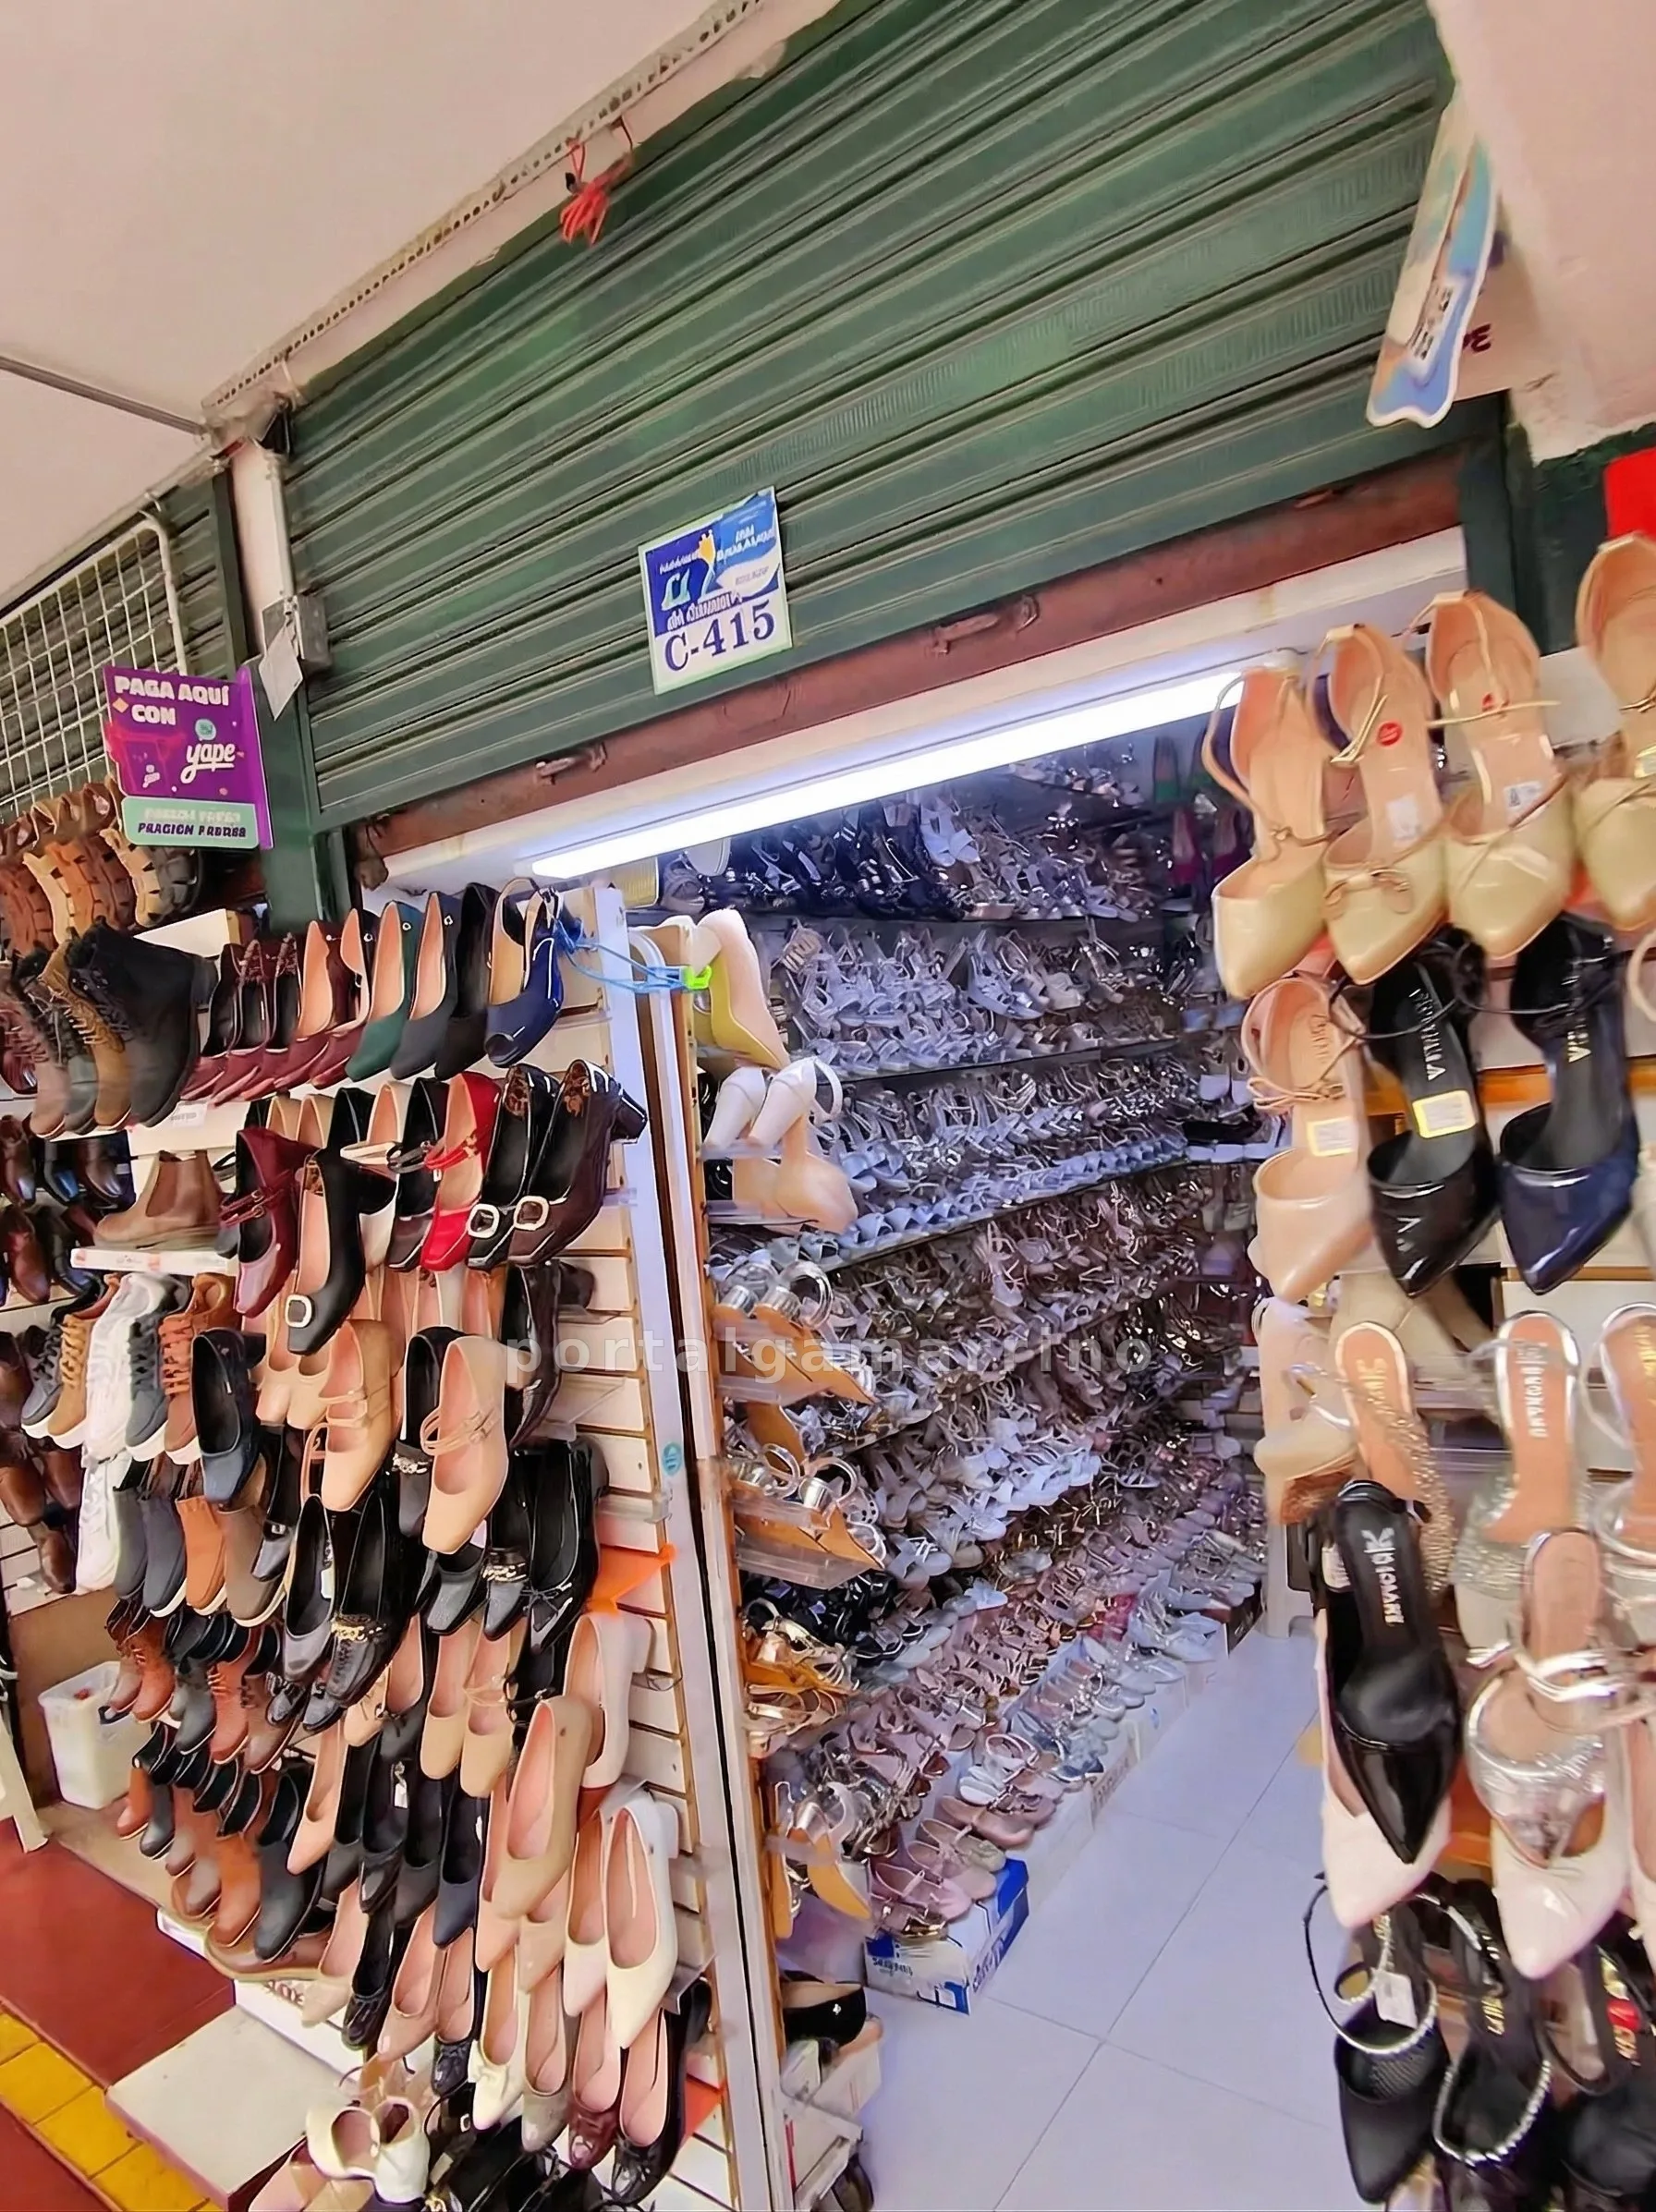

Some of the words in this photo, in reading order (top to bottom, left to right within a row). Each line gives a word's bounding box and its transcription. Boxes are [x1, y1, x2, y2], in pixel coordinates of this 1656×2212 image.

[664, 598, 775, 672] C-415
[114, 675, 175, 700] PAGA
[131, 704, 176, 725] CON
[180, 743, 236, 784] yape
